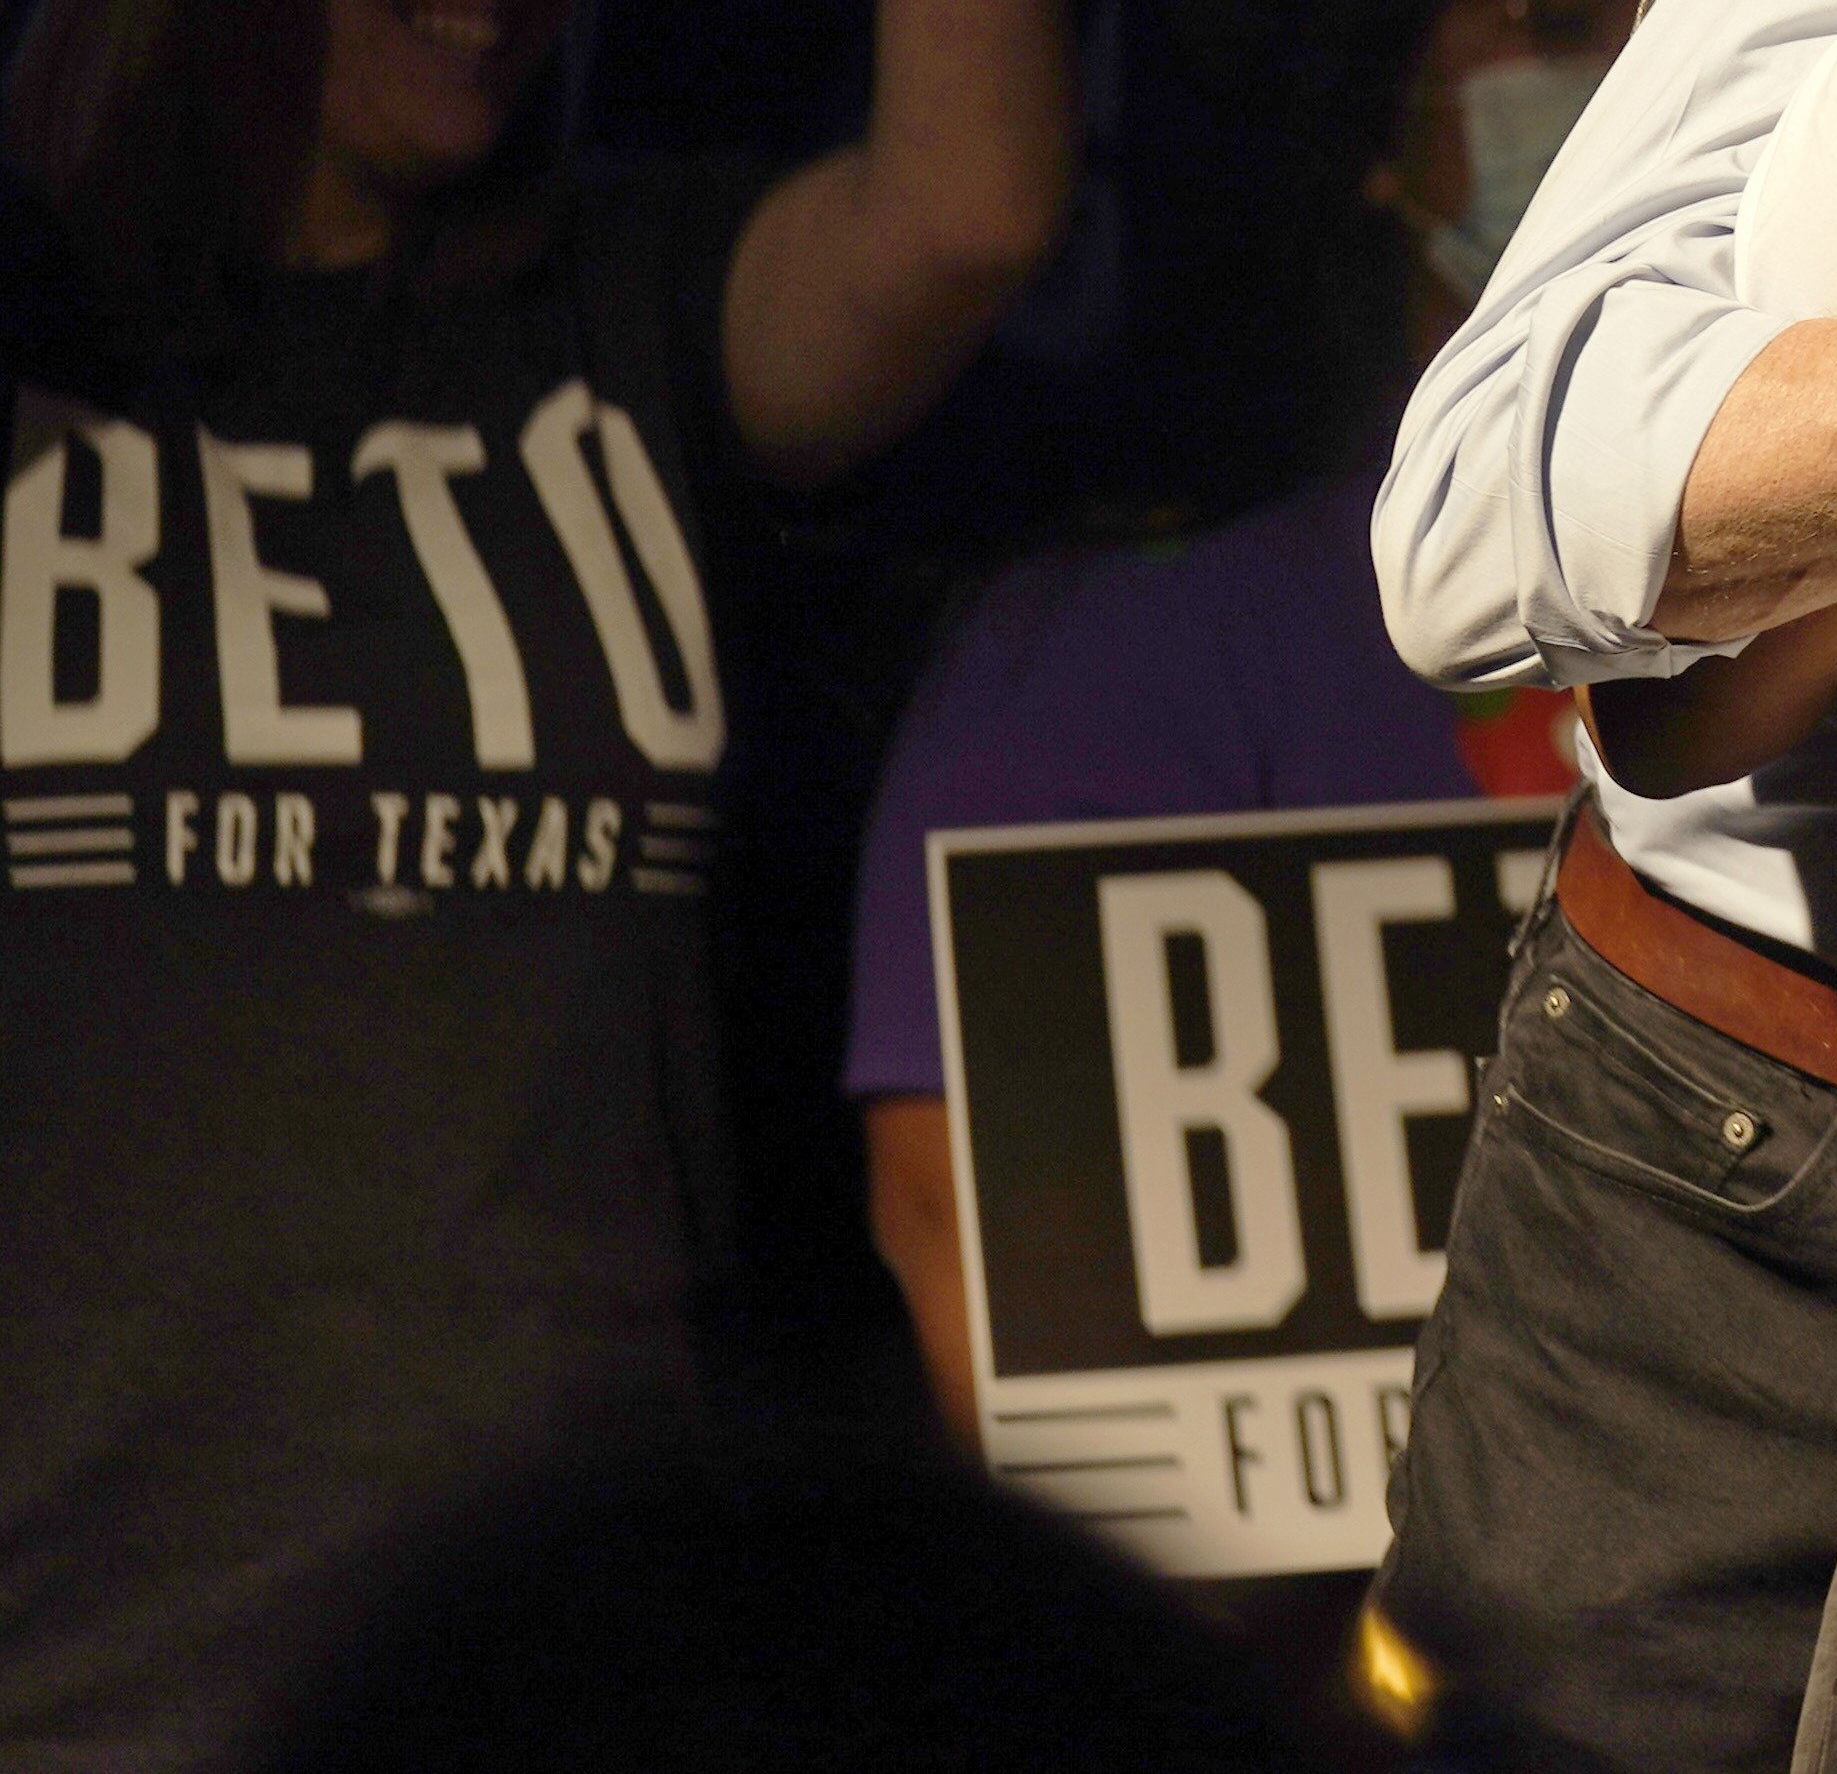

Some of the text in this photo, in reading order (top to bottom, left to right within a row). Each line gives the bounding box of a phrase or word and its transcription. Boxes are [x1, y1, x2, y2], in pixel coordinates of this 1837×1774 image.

[0, 374, 729, 772] BETO
[163, 789, 623, 894] FOR TEXAS
[1097, 847, 1555, 1338] BE
